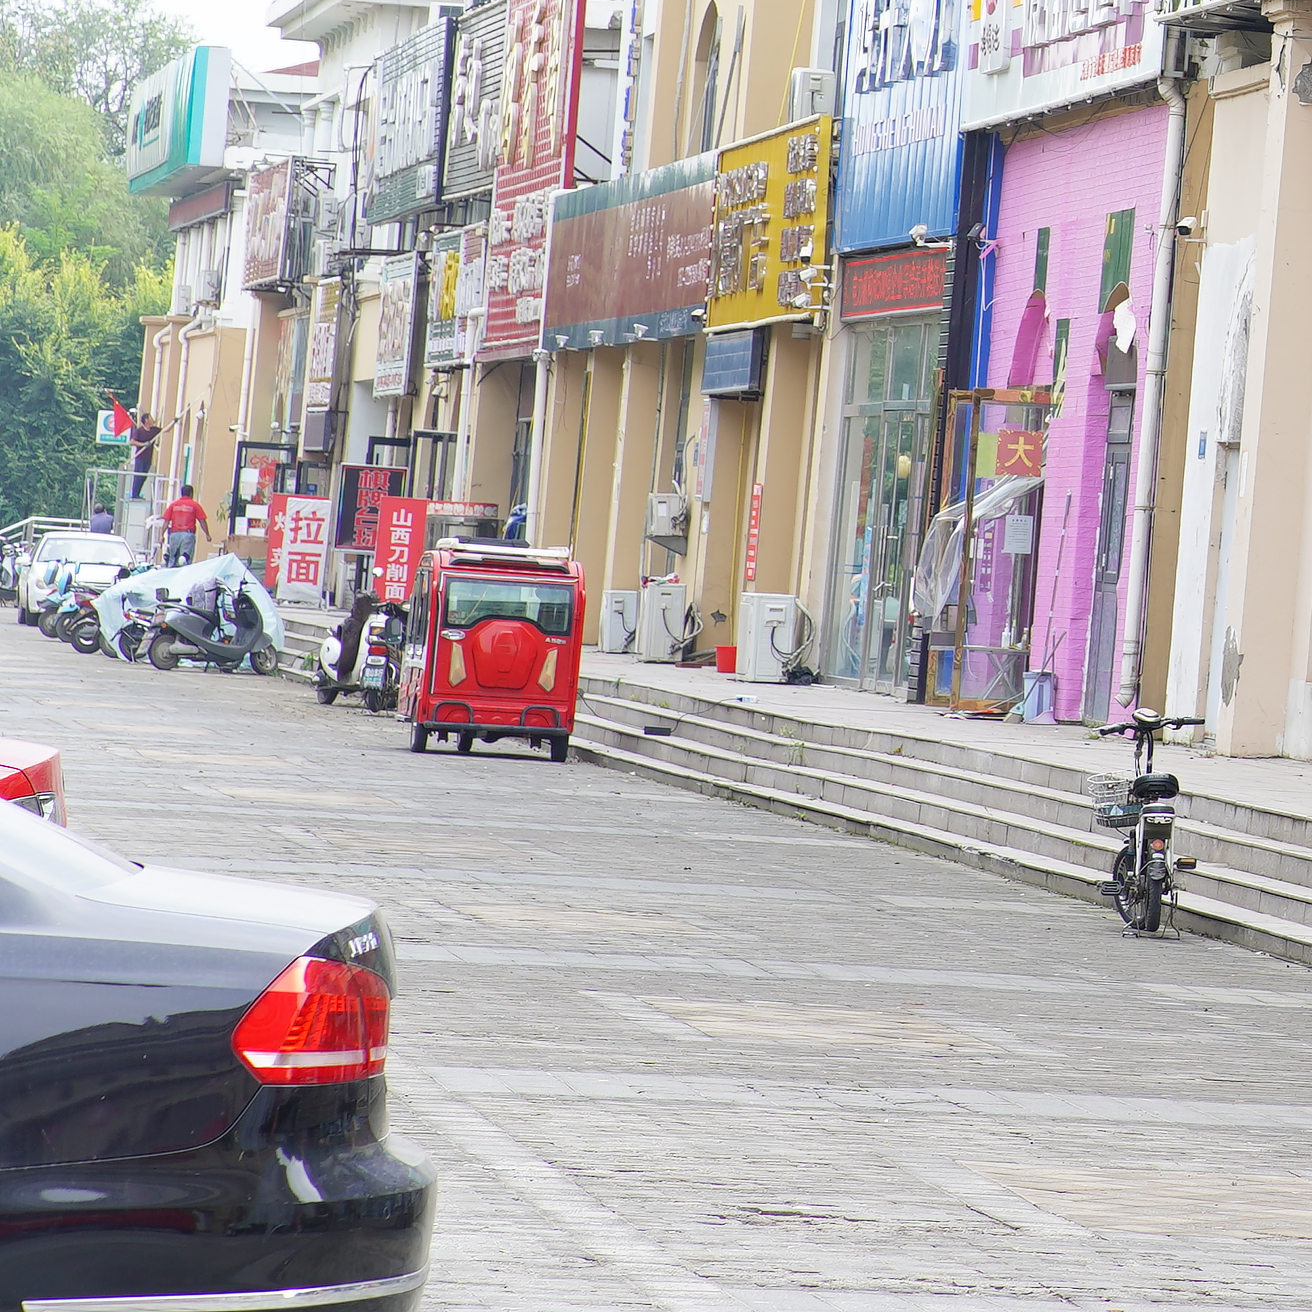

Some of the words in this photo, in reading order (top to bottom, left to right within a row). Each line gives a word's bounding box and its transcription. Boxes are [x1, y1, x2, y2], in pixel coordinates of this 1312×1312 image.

[1003, 435, 1036, 469] 大
[286, 510, 325, 586] 拉面
[384, 508, 413, 600] 山西刀削面
